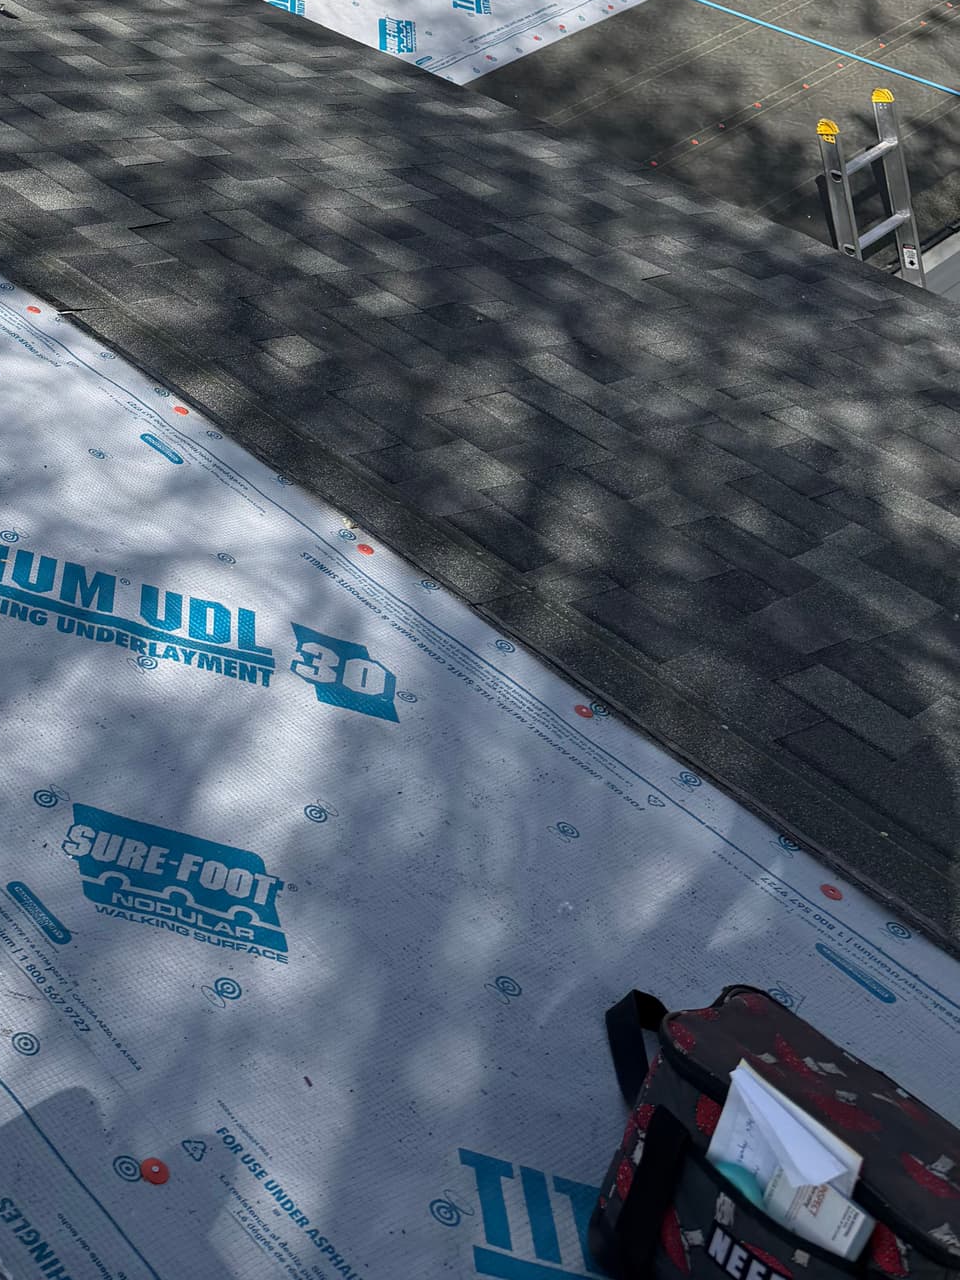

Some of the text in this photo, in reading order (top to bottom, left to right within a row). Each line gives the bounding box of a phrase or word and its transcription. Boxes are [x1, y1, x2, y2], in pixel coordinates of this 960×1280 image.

[298, 546, 338, 583] SHINGLES
[335, 573, 382, 617] COMPOSITE
[56, 615, 274, 688] UNDERLAYMENT
[141, 584, 273, 656] UDL
[291, 640, 397, 697] 30
[758, 873, 790, 898] 9727
[95, 904, 189, 942] WALKING
[192, 925, 289, 965] SURFACE
[112, 892, 256, 942] NODULAR
[24, 960, 47, 985] 800
[43, 983, 65, 1007] 567
[61, 1003, 91, 1036] 9727
[213, 1124, 311, 1230] FOR USE UNDER
[226, 1184, 272, 1234] resistencia
